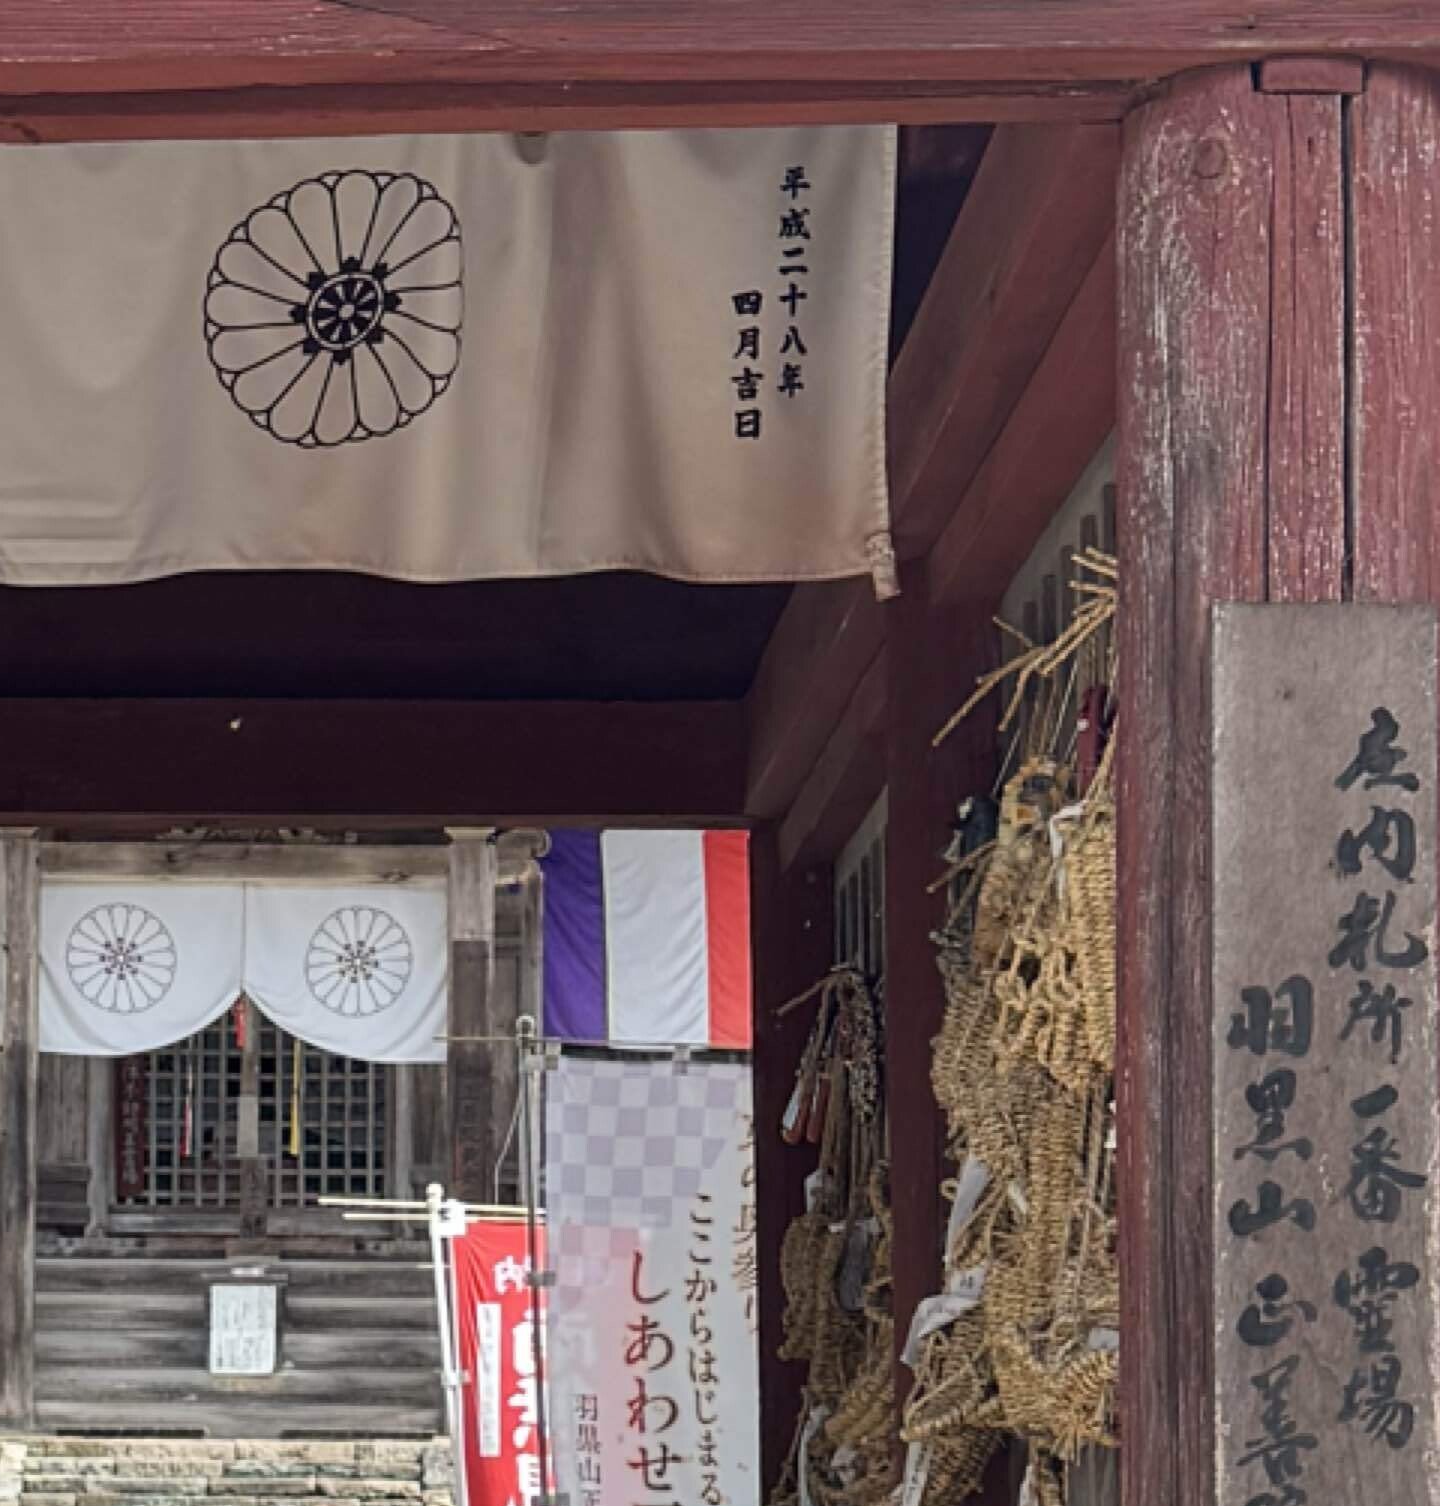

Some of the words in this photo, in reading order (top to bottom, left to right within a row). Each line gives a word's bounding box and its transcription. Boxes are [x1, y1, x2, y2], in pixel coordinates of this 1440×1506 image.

[730, 290, 764, 440] 四月吉日
[776, 165, 811, 399] 平成二十八年
[684, 1192, 721, 1506] ここからはじまる
